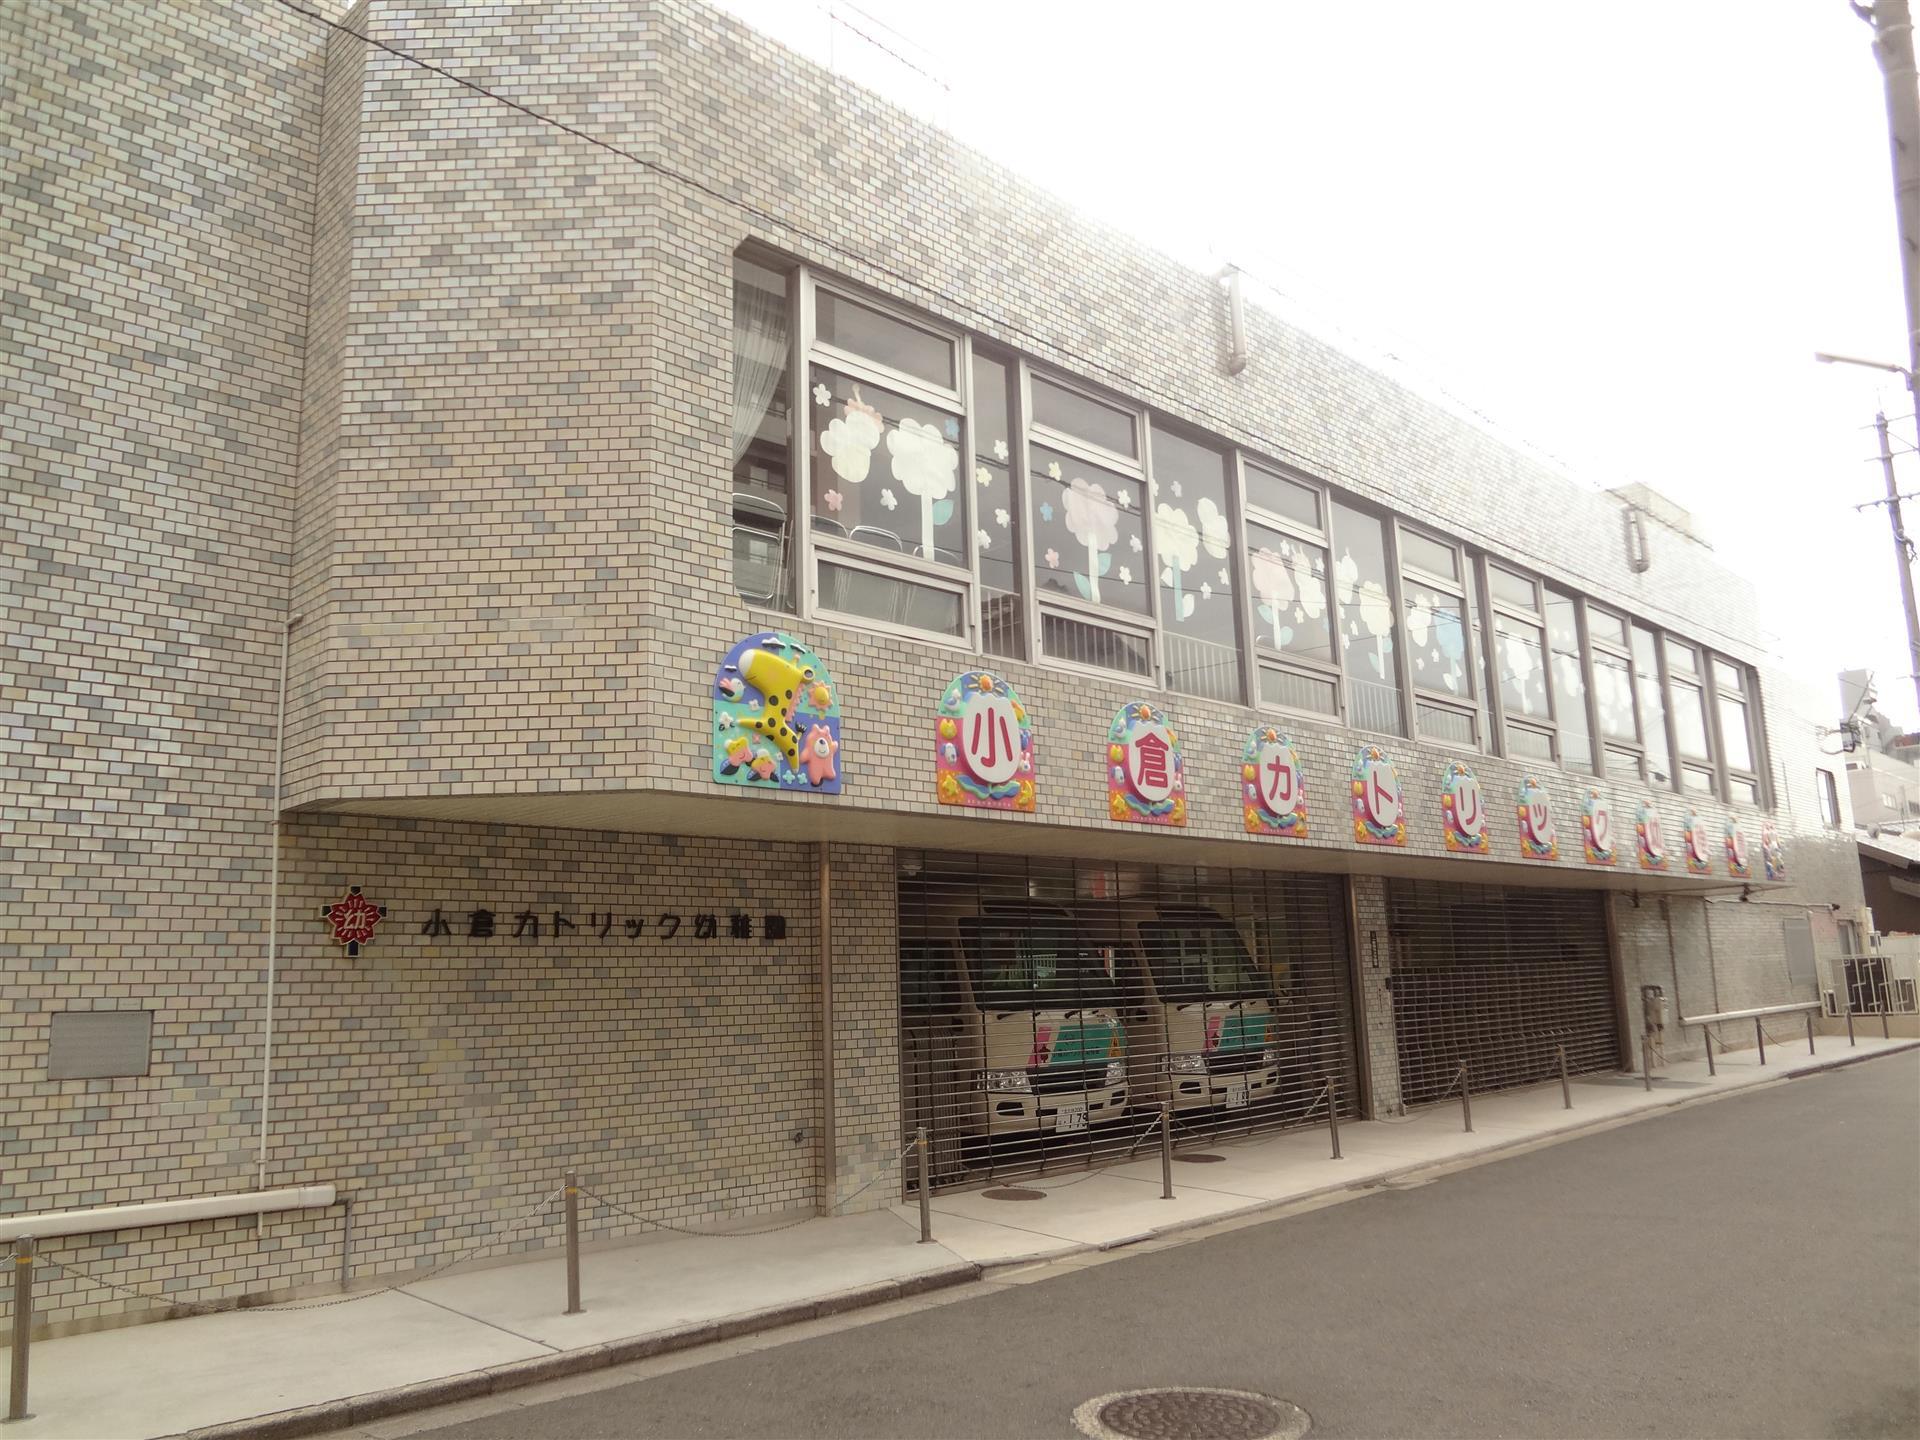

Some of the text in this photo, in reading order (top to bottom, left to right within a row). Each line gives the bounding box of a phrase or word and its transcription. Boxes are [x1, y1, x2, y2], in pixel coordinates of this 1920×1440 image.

[971, 707, 1014, 768] 小
[1134, 732, 1169, 788] 倉
[1266, 754, 1292, 802] カ
[1373, 770, 1394, 815] ト
[1459, 786, 1477, 826] リ
